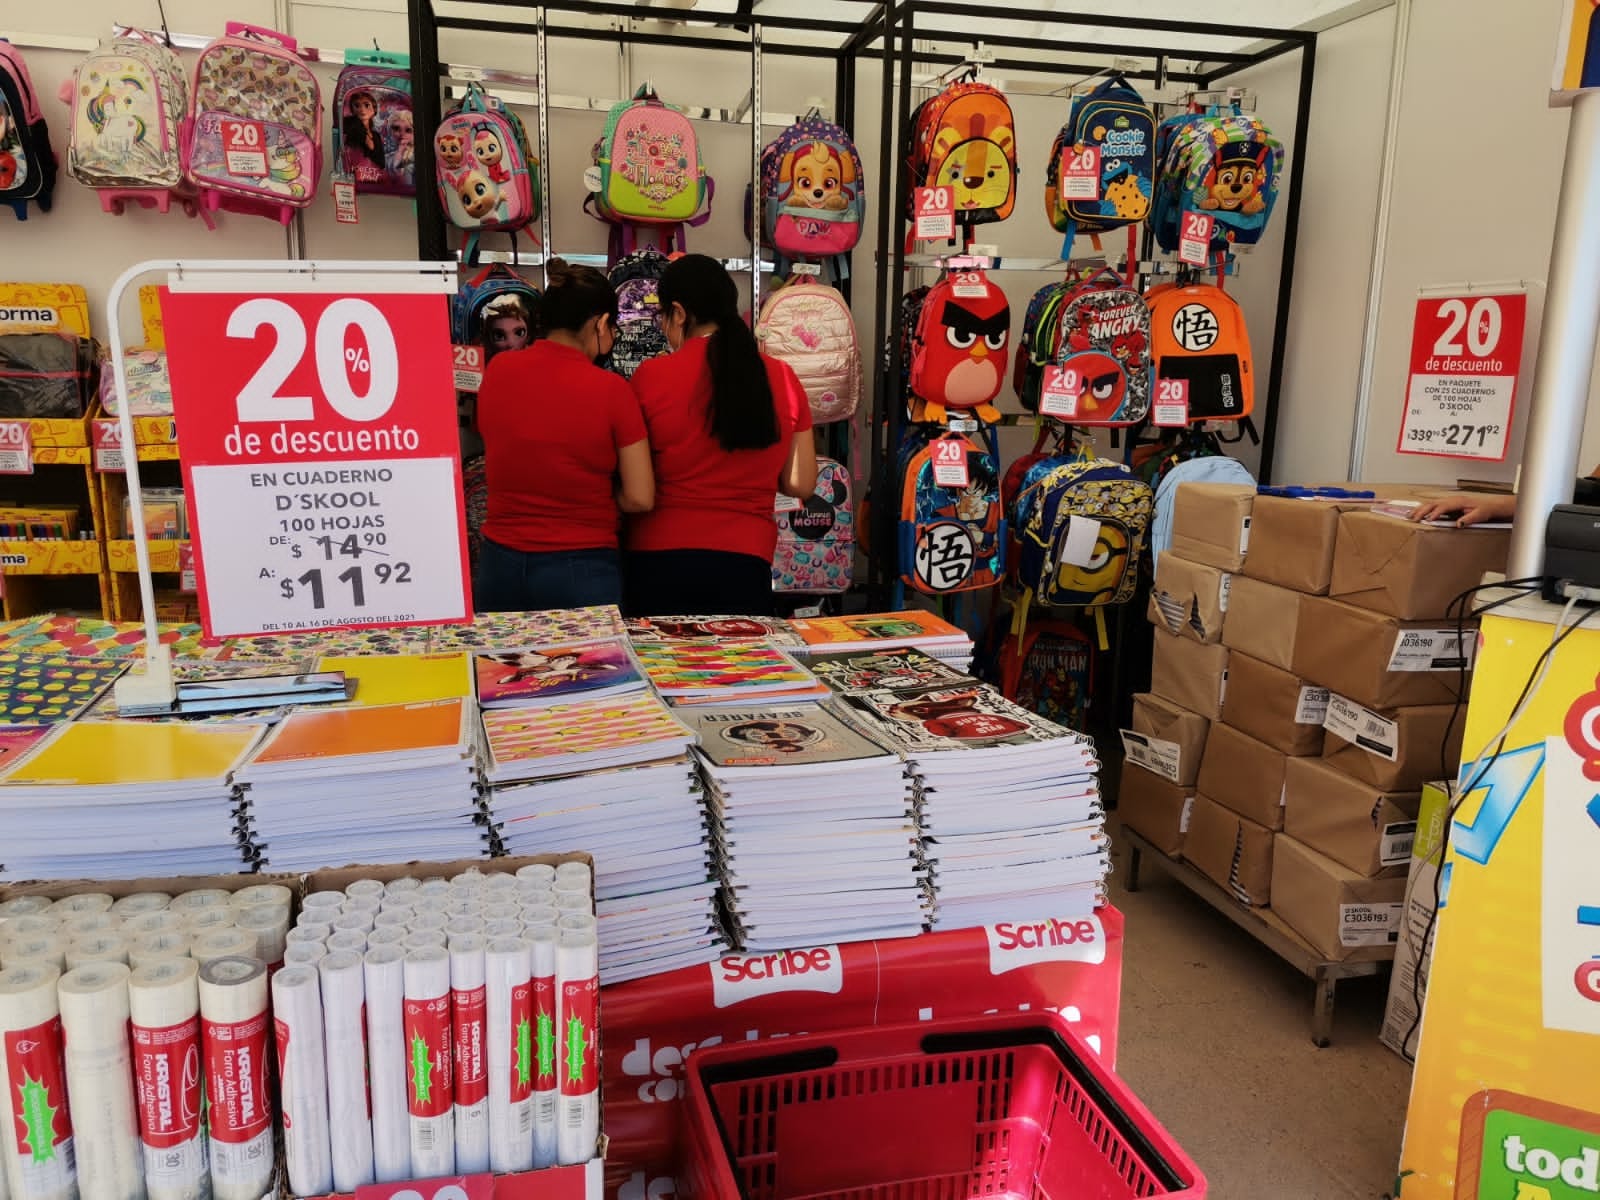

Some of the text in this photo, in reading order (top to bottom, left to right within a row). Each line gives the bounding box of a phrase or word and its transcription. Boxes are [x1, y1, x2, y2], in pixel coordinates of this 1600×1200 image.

[1106, 129, 1145, 143] Cookie
[1100, 143, 1146, 157] Monster
[922, 188, 948, 209] 20
[1187, 215, 1208, 237] 20
[1099, 303, 1137, 320] FOREVER
[1091, 314, 1141, 339] ANGRY
[1176, 306, 1217, 350] 悟
[454, 346, 478, 366] 20
[1426, 357, 1503, 372] de descuento
[1160, 381, 1183, 400] 20
[224, 424, 420, 456] de descuento
[937, 441, 960, 460] 20
[251, 468, 393, 487] EN CUADERNO
[280, 515, 385, 532] 100 HOJAS
[794, 518, 832, 527] MOUSE
[270, 535, 291, 546] DE:
[920, 527, 972, 588] 悟
[259, 567, 276, 578] A:
[262, 623, 280, 631] DEL
[336, 616, 374, 626] AGOSTO
[376, 615, 392, 623] DEL
[394, 613, 416, 621] 2021
[704, 711, 804, 722] SEAFARER
[996, 916, 1096, 951] Scribe
[722, 946, 832, 984] Scribe
[143, 1054, 155, 1131] Forro Adhesivo
[155, 1053, 173, 1131] KRYSTAL
[223, 1050, 238, 1127] Forro Adhesivo
[237, 1046, 256, 1125] KRYSTAL
